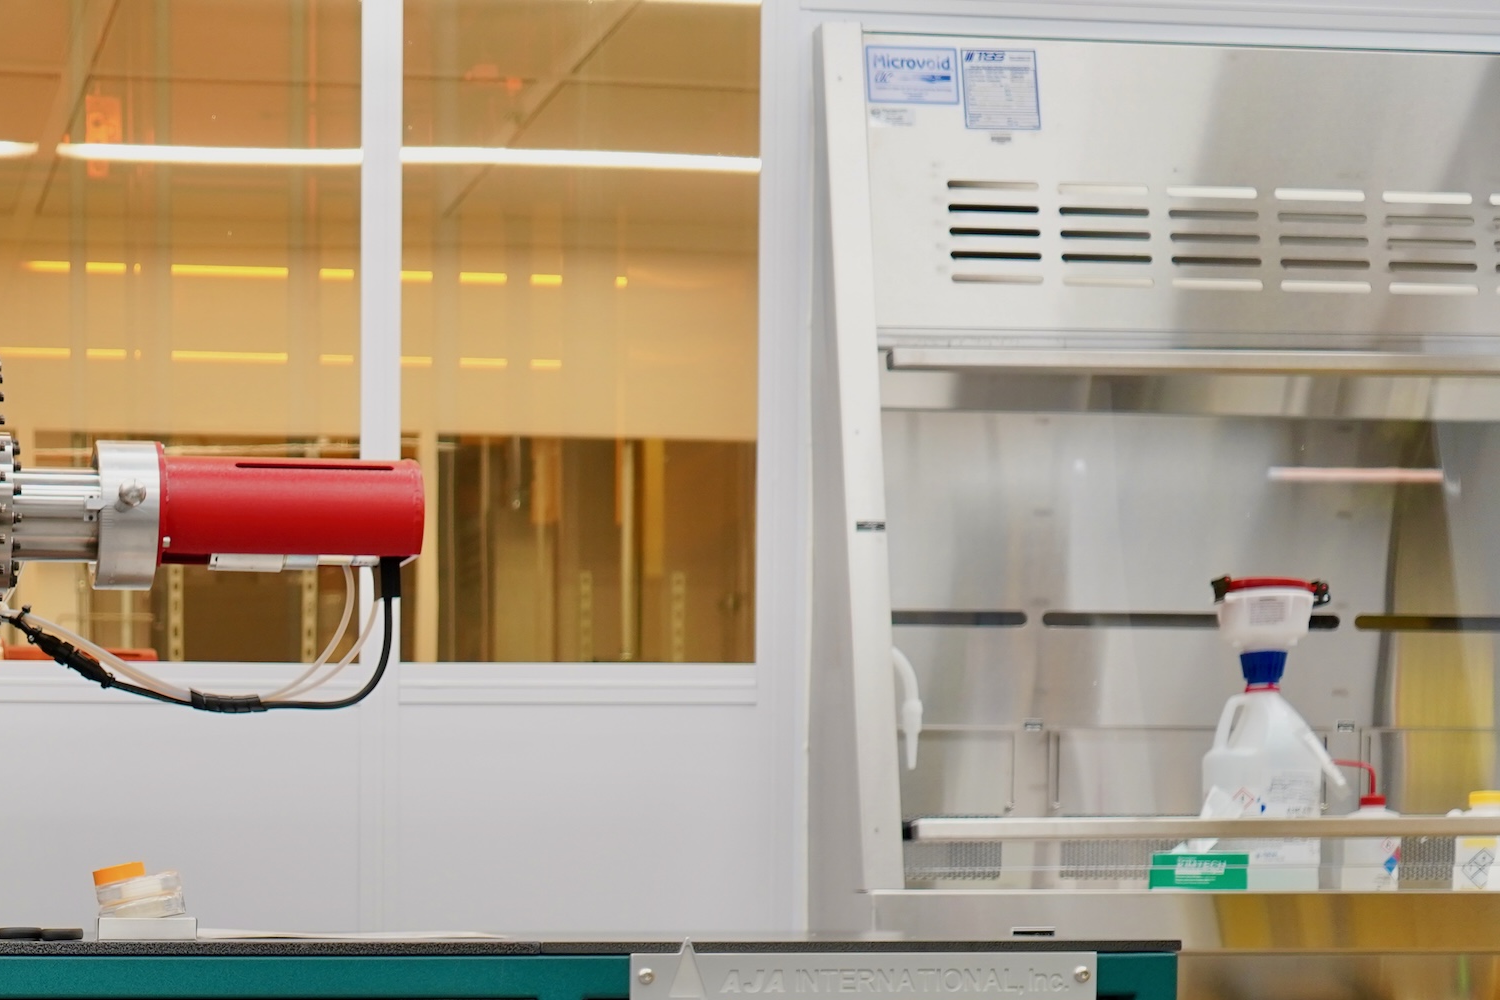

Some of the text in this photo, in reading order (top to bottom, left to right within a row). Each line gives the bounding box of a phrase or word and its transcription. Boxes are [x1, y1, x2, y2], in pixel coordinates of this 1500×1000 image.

[873, 54, 950, 70] Microvoid
[719, 967, 1070, 996] AJA INTERNATIONAL, Inc.
